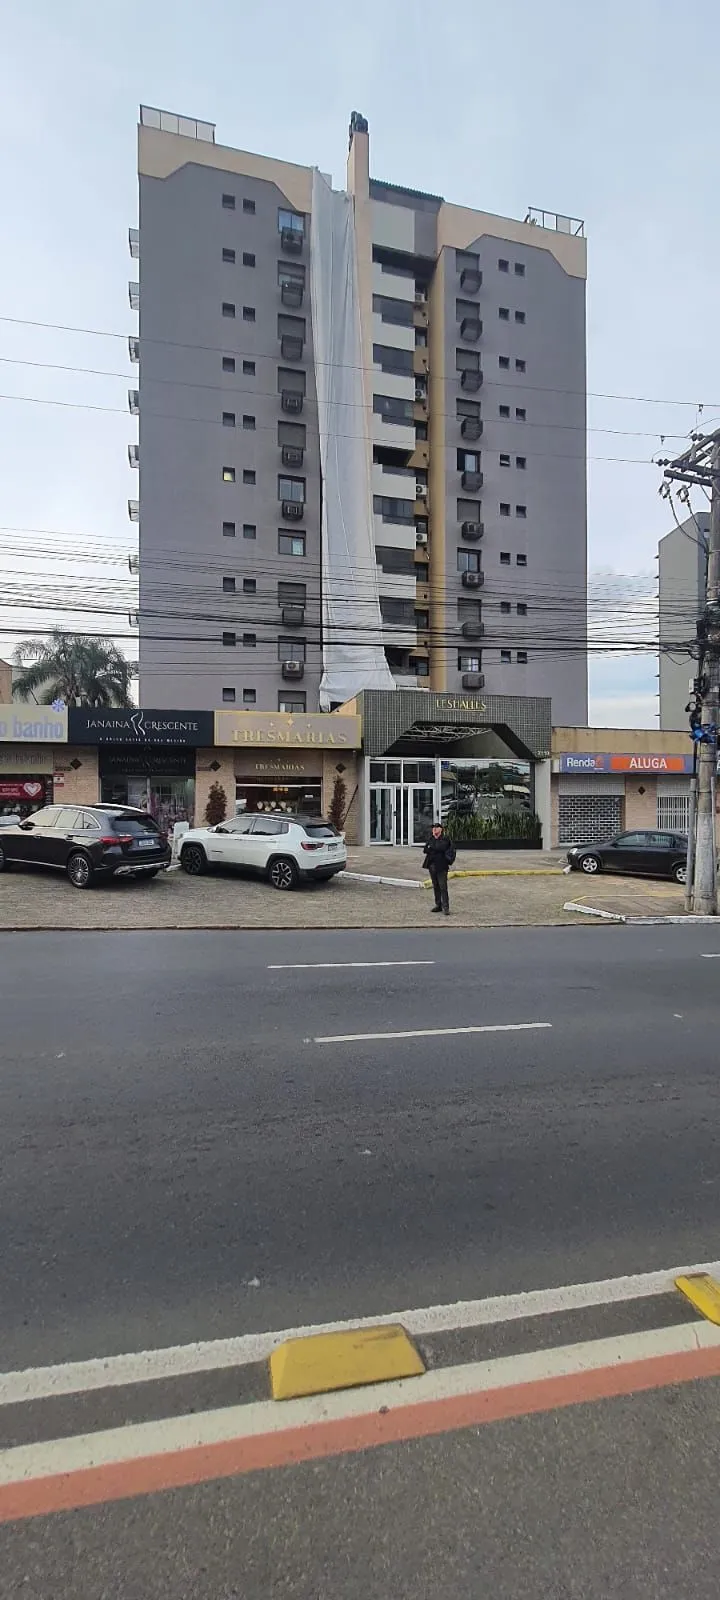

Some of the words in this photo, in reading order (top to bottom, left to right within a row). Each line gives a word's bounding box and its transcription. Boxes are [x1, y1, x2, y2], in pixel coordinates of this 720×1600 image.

[12, 714, 64, 739] banho
[86, 719, 130, 729] JANAINA
[144, 721, 199, 731] CRESCENTE
[566, 757, 596, 768] Renda
[629, 757, 668, 769] ALUGA
